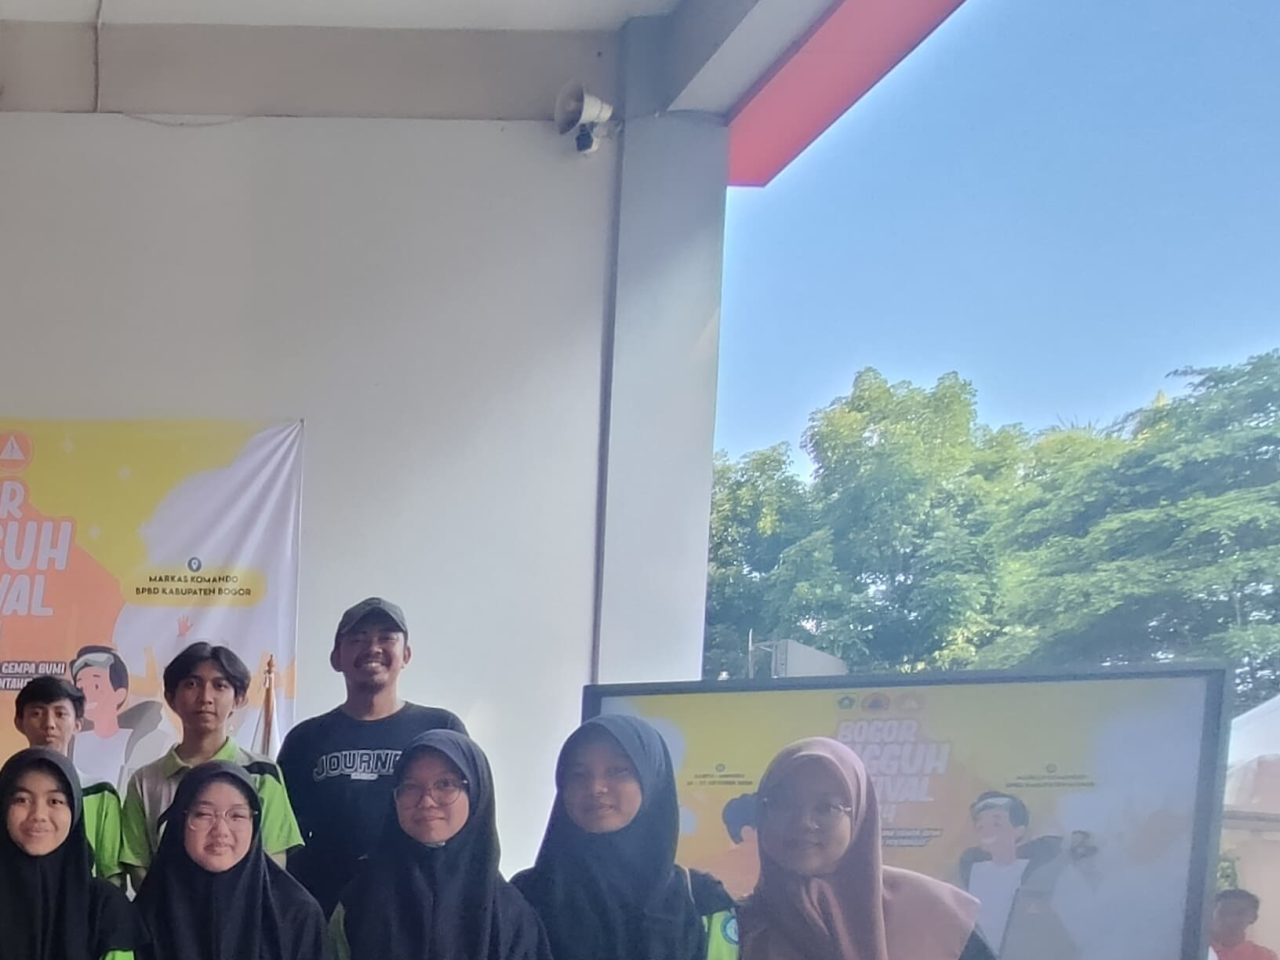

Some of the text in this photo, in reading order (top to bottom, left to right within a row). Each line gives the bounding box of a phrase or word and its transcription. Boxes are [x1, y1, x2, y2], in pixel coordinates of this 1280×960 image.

[149, 575, 238, 584] MARKAS KOMANDO
[135, 587, 251, 596] BPBD KABUPATEN BOGOR
[2, 662, 35, 674] GEMPA
[38, 662, 66, 674] BUMI
[838, 720, 918, 742] BOGOR
